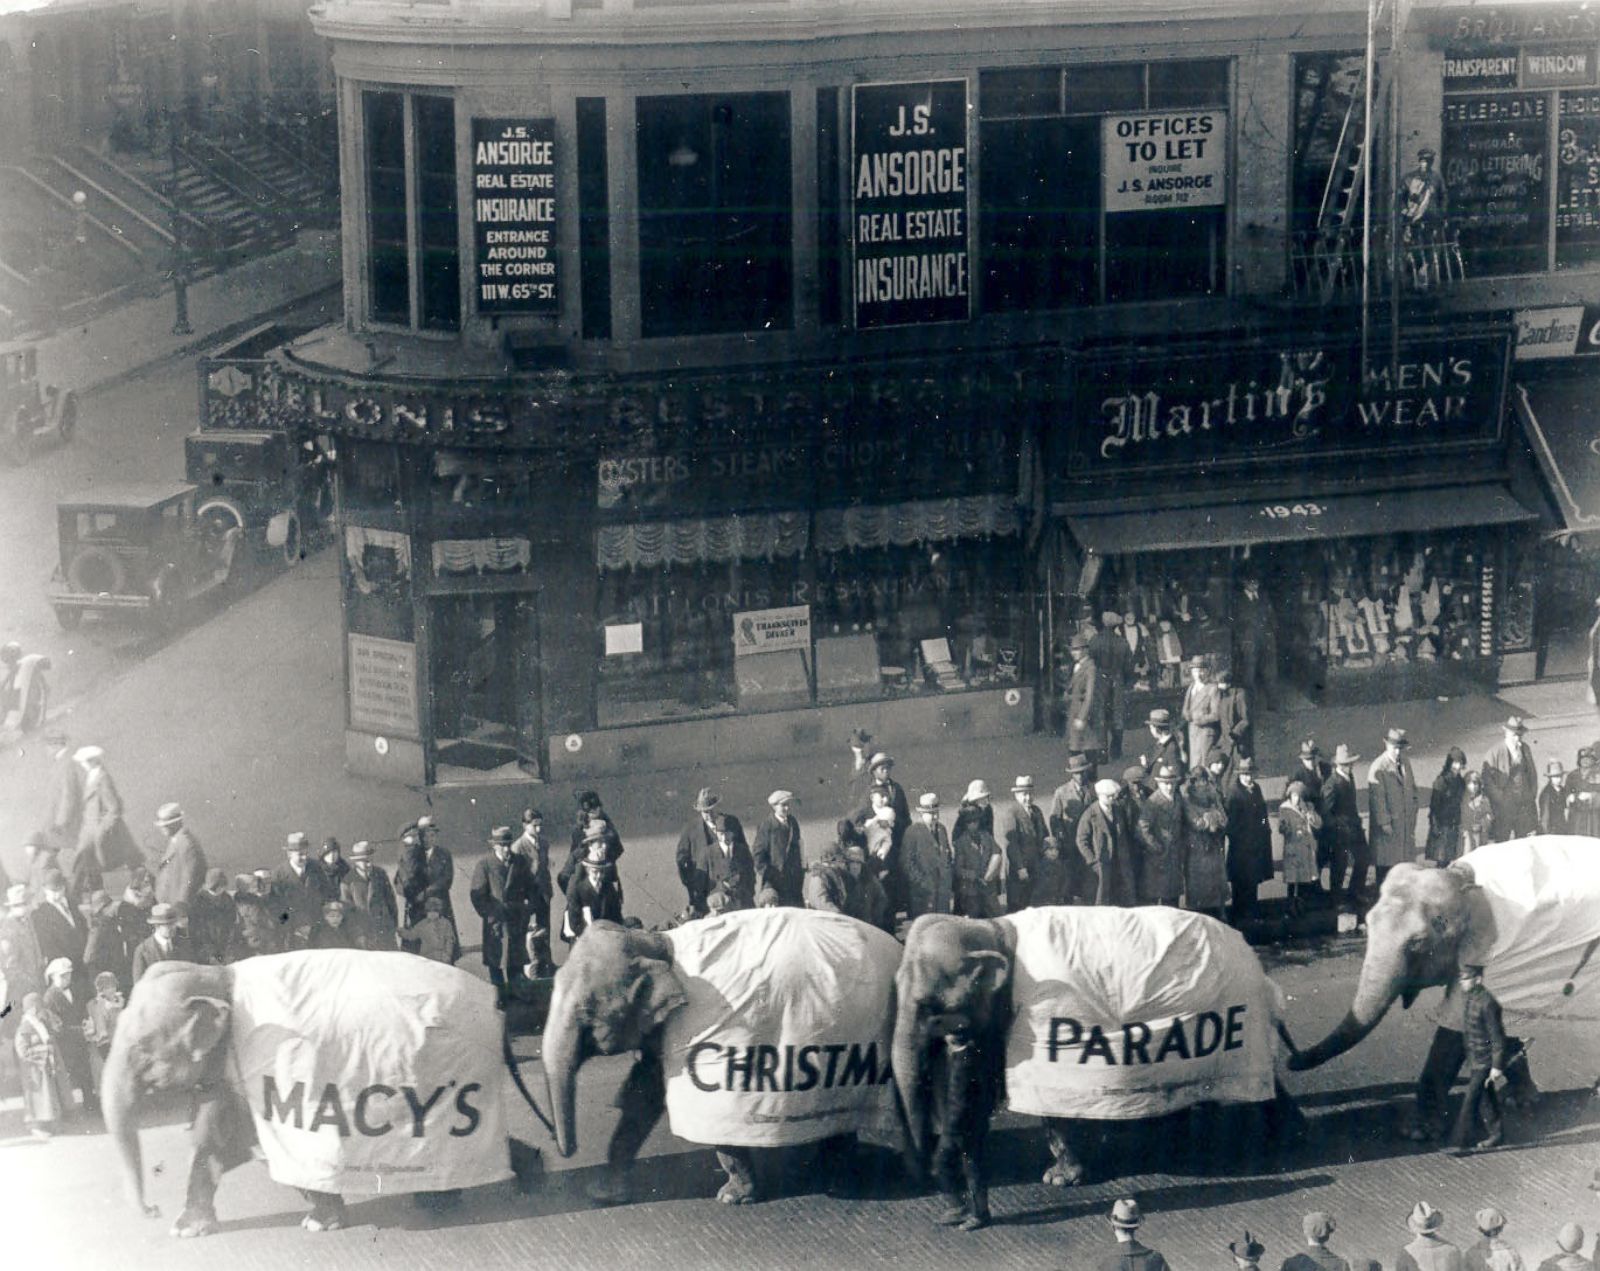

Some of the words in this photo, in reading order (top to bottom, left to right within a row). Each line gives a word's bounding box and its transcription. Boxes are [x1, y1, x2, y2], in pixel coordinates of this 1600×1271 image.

[1442, 57, 1517, 77] TRANSPARENT
[1527, 55, 1587, 75] WINDOW
[888, 104, 936, 137] J.S.
[1447, 99, 1545, 121] TELEPHONE
[502, 127, 530, 139] J.S.
[1116, 115, 1214, 138] OFFICES
[476, 141, 554, 166] ANSORGE
[1125, 140, 1156, 163] TO
[1165, 138, 1208, 160] LET
[856, 147, 966, 199] ANSORGE
[1482, 153, 1543, 183] LETTERING
[476, 174, 508, 189] REAL
[510, 173, 554, 189] ESTATE
[1147, 174, 1213, 191] ANSORGE
[477, 198, 555, 222] INSURANCE
[486, 230, 549, 244] ENTRANCE
[858, 213, 902, 243] REAL
[906, 207, 963, 240] ESTATE
[487, 247, 548, 260] AROUND
[480, 264, 504, 276] THE
[505, 262, 556, 276] CORNER
[857, 251, 967, 304] INSURANCE
[538, 283, 556, 300] ST.
[1366, 356, 1472, 392] MEN'S
[1357, 398, 1467, 427] WEAR
[598, 456, 690, 486] OYSTERS
[1047, 1004, 1248, 1066] PARADE
[261, 1075, 482, 1138] MACY'S
